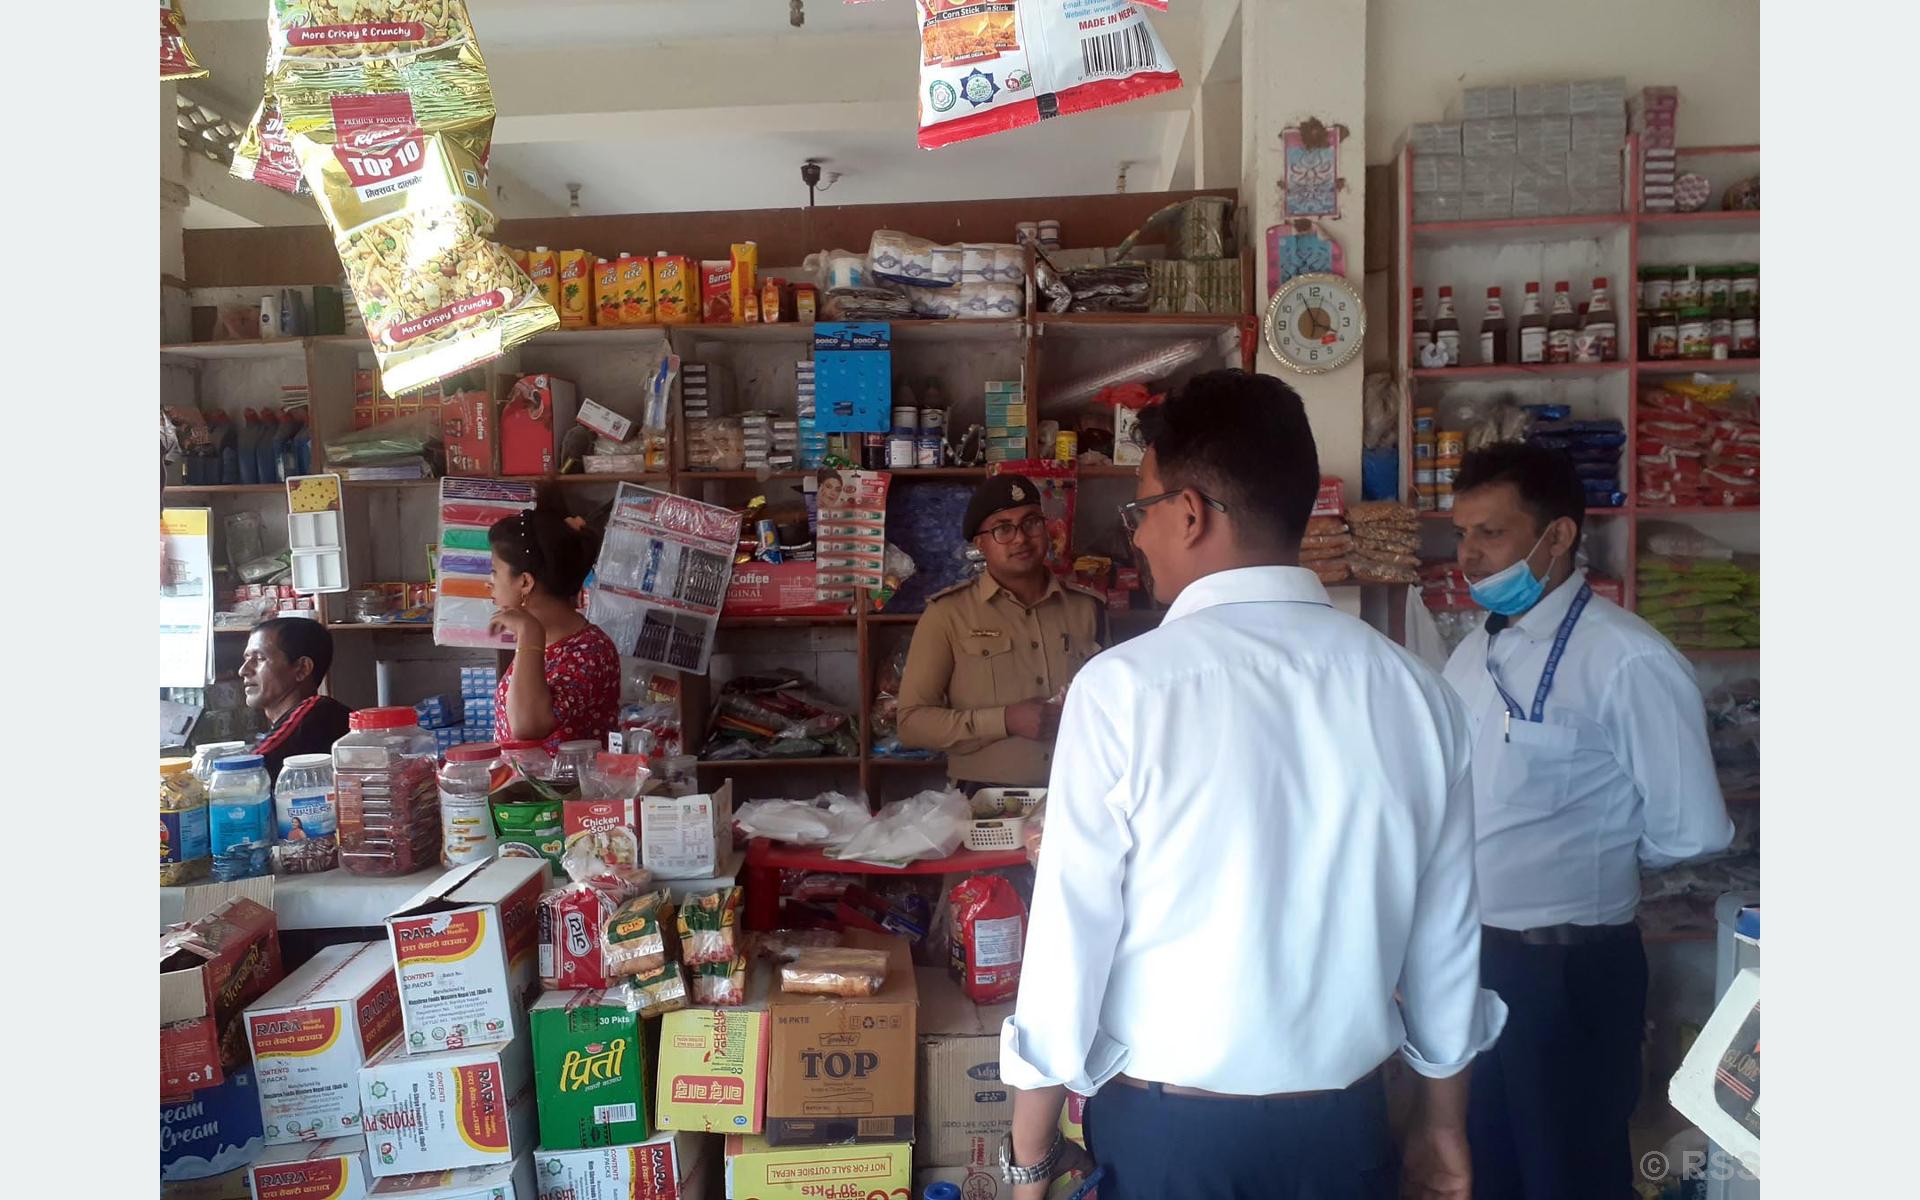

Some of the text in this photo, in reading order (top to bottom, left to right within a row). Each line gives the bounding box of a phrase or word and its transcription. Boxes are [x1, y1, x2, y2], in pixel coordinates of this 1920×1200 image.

[942, 6, 980, 19] Corn Stick
[1079, 17, 1106, 31] MADE
[1108, 14, 1117, 24] IN
[1118, 6, 1138, 20] NEPAL
[301, 27, 411, 40] More Crispy & Crunchy
[347, 140, 420, 176] TOP 10
[1309, 287, 1320, 297] 12
[1282, 305, 1292, 313] 10
[1338, 302, 1346, 311] 2
[402, 324, 421, 335] More
[423, 312, 451, 328] Crispy
[459, 297, 493, 314] Crunchy
[1343, 317, 1351, 327] 3
[1278, 320, 1287, 330] 9
[1283, 337, 1290, 345] 8
[1339, 334, 1345, 342] 4
[1310, 350, 1318, 360] 6
[1326, 346, 1334, 355] 5
[731, 573, 769, 585] Coffee
[727, 589, 762, 598] IGINAL
[582, 816, 620, 828] Chicken
[590, 824, 615, 834] SOUP
[403, 971, 434, 982] CONTENTS
[411, 981, 432, 990] PACKS
[599, 1016, 630, 1025] 30 Pkts
[789, 1016, 810, 1024] PKTS
[256, 1020, 301, 1037] RARA
[801, 1051, 880, 1079] TOP
[266, 1076, 287, 1084] PACKS
[428, 1080, 436, 1101] PACKS
[436, 1071, 445, 1103] CONTENTS
[478, 1068, 495, 1115] RARA
[382, 1110, 416, 1132] FOODS
[160, 1121, 219, 1152] Cream
[611, 1148, 619, 1181] CONTENTS
[652, 1148, 667, 1193] RARA
[771, 1163, 886, 1178] NOT FOR SALE OUTSIDE NEPAL
[260, 1171, 307, 1188] RARA
[801, 1182, 857, 1198] 30 Pkts
